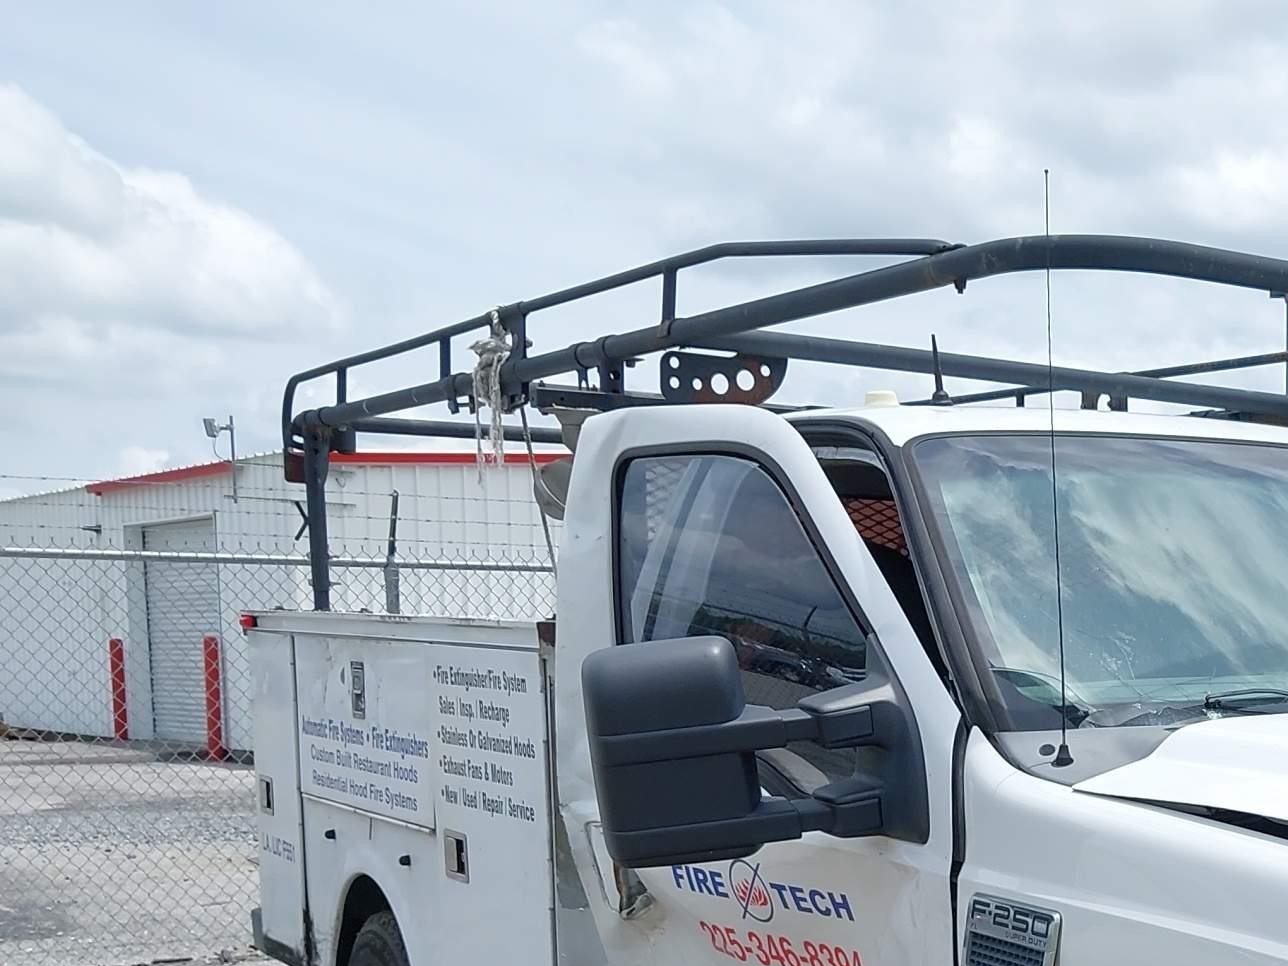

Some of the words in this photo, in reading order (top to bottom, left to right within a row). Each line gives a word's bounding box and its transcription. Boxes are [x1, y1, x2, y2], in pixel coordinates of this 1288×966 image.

[437, 665, 449, 684] Fire
[502, 671, 527, 696] System
[439, 696, 456, 716] Sales
[479, 700, 510, 728] Recharge
[328, 719, 340, 741] Fire
[340, 720, 365, 748] Systems
[371, 726, 384, 750] Fire
[384, 728, 429, 760] Extinguishers
[441, 725, 468, 748] Stainless
[469, 729, 478, 749] Or
[478, 730, 513, 754] Galvanized
[513, 735, 535, 759] Hoods
[310, 743, 335, 764] Custom
[336, 749, 352, 768] Built
[353, 752, 392, 777] Restaurant
[393, 761, 419, 784] Hoods
[443, 754, 467, 777] Exhaust
[467, 759, 483, 780] Fans
[484, 761, 490, 781] &
[491, 763, 514, 786] Motors
[312, 769, 348, 792] Residential
[349, 778, 368, 799] Hood
[369, 783, 384, 802] Fire
[385, 786, 419, 812] Systems
[444, 784, 458, 804] New
[462, 787, 478, 809] Used
[482, 791, 504, 818] Repair
[508, 797, 535, 822] Service
[672, 864, 730, 899] FIRE
[769, 882, 855, 922] TECH
